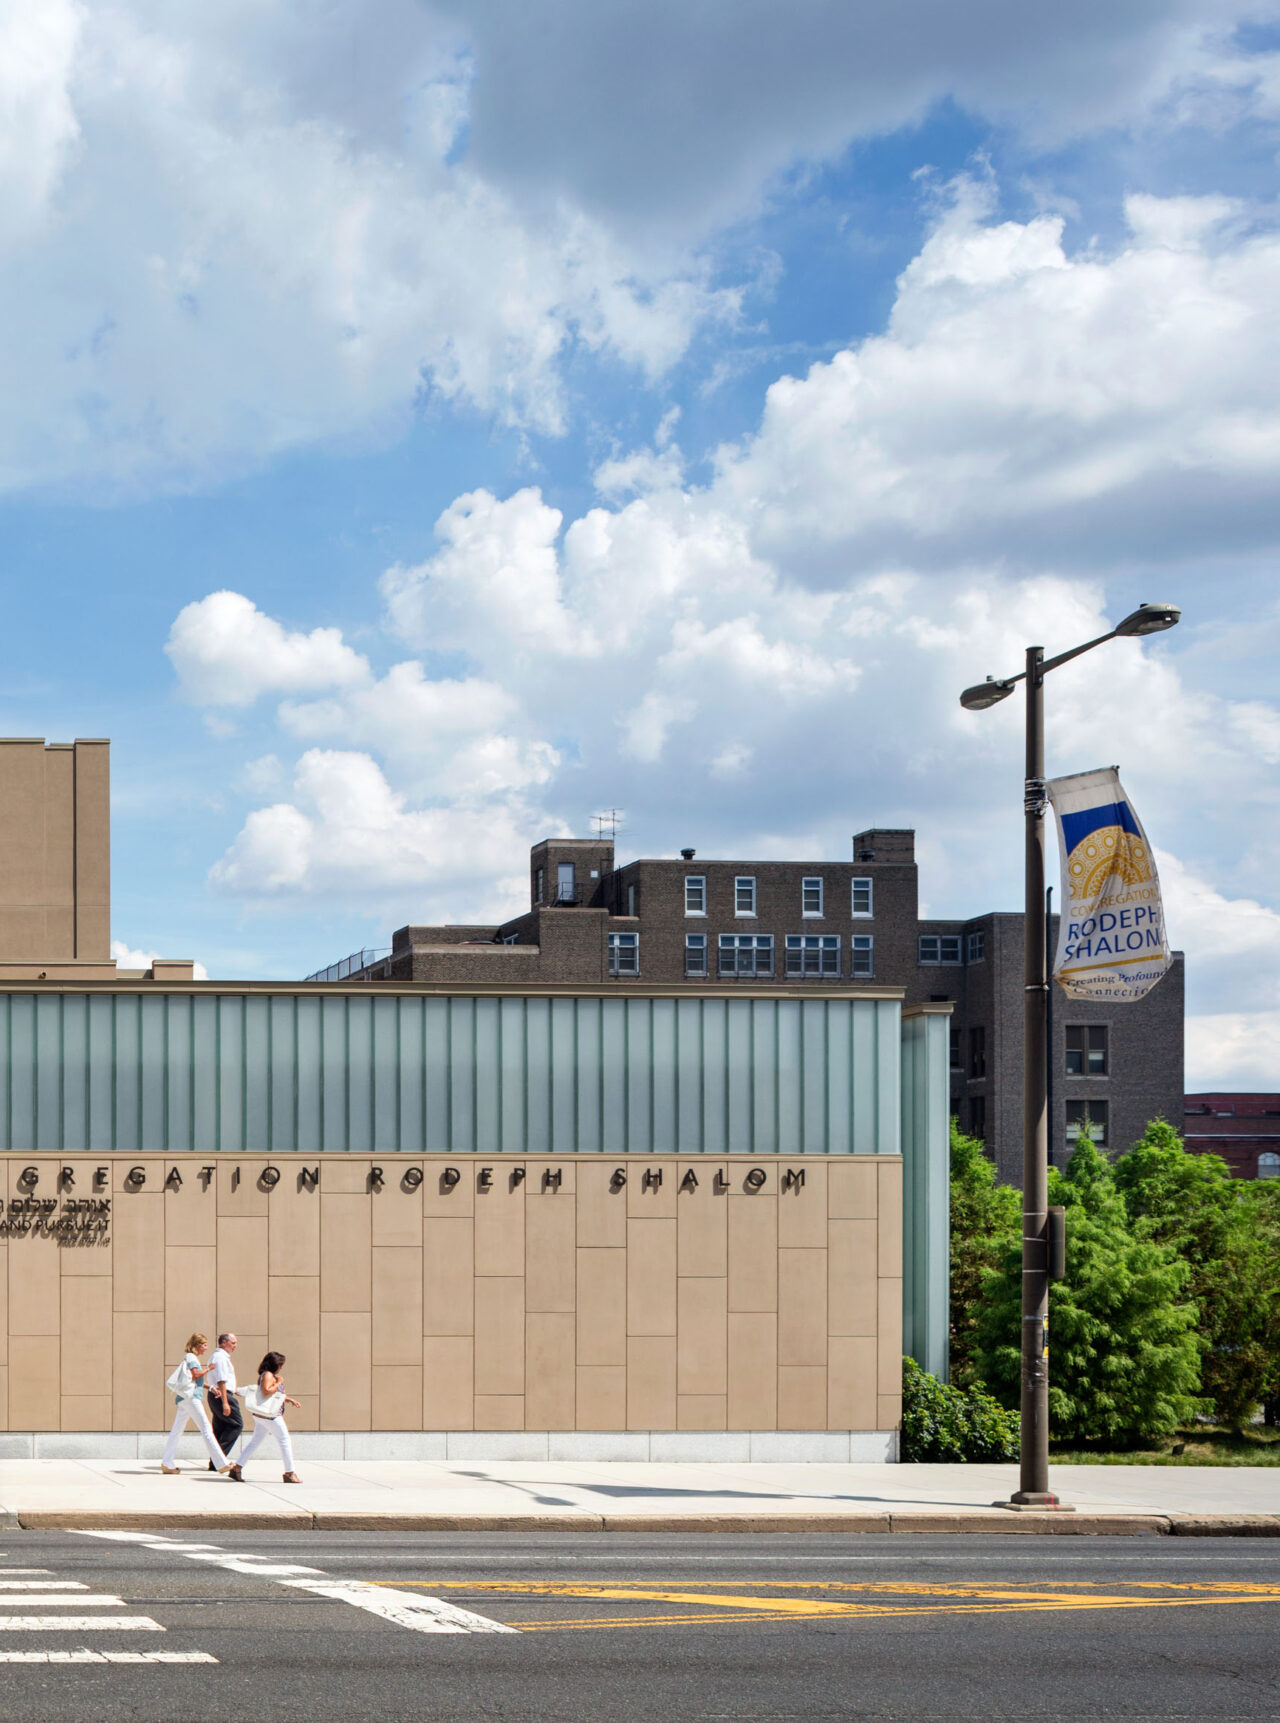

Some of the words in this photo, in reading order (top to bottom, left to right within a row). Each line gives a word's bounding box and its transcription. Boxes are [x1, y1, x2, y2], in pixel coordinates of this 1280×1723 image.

[1066, 975, 1115, 988] Creating
[371, 1166, 562, 1186] RODEPH
[613, 1167, 806, 1187] SHALOM
[12, 1192, 58, 1213] שלום
[67, 1198, 111, 1212] אוהב
[0, 1220, 32, 1231] AND
[36, 1220, 94, 1231] PURSUE
[97, 1220, 110, 1231] IT
